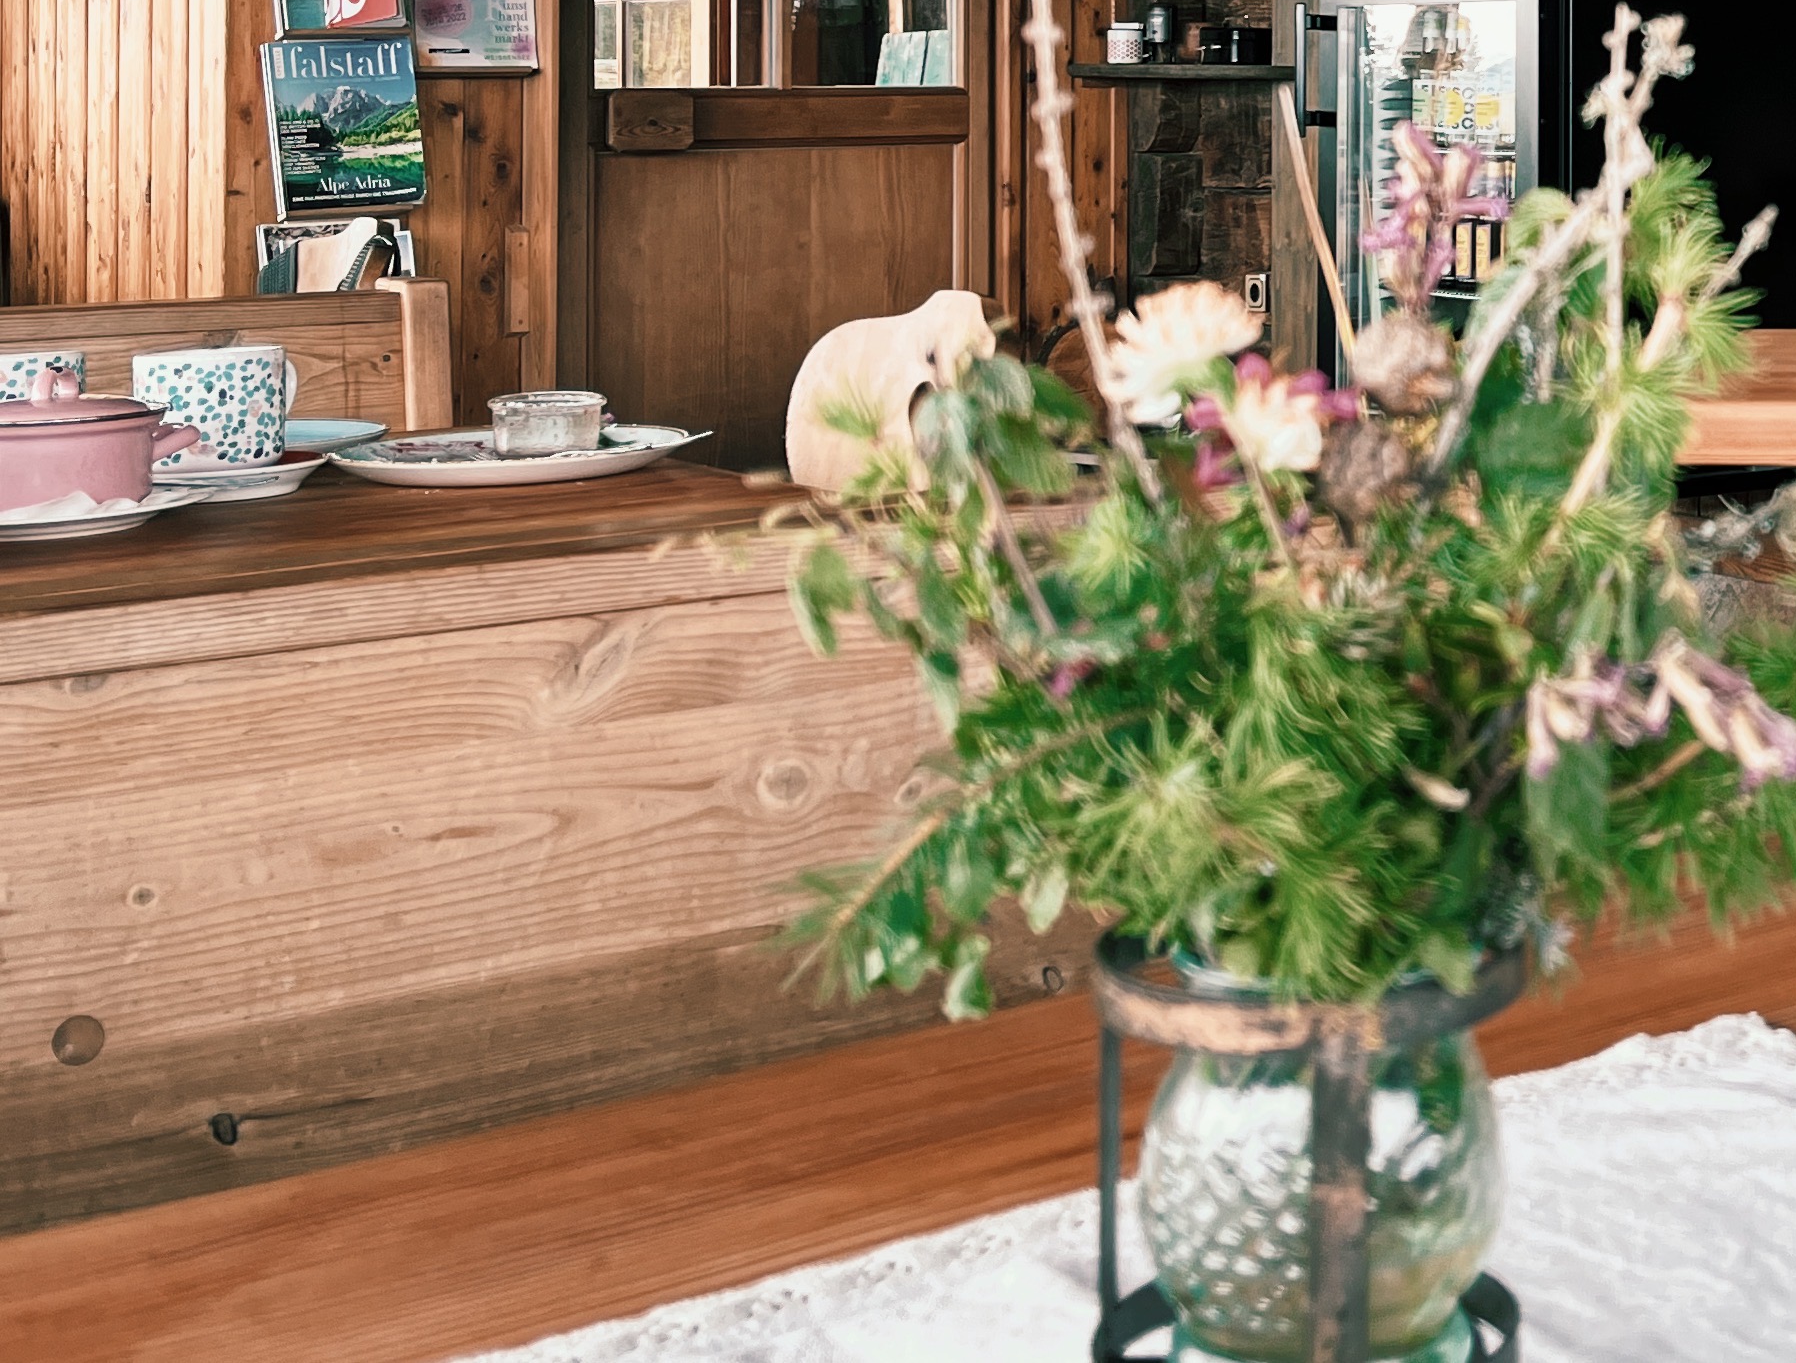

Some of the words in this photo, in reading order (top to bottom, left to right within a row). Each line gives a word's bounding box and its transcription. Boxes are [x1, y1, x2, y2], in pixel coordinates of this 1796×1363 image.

[498, 10, 528, 22] hand
[495, 21, 529, 33] werks
[494, 33, 529, 44] markt
[290, 42, 402, 79] falstaff
[316, 177, 350, 195] Alpe
[352, 174, 392, 191] Adria
